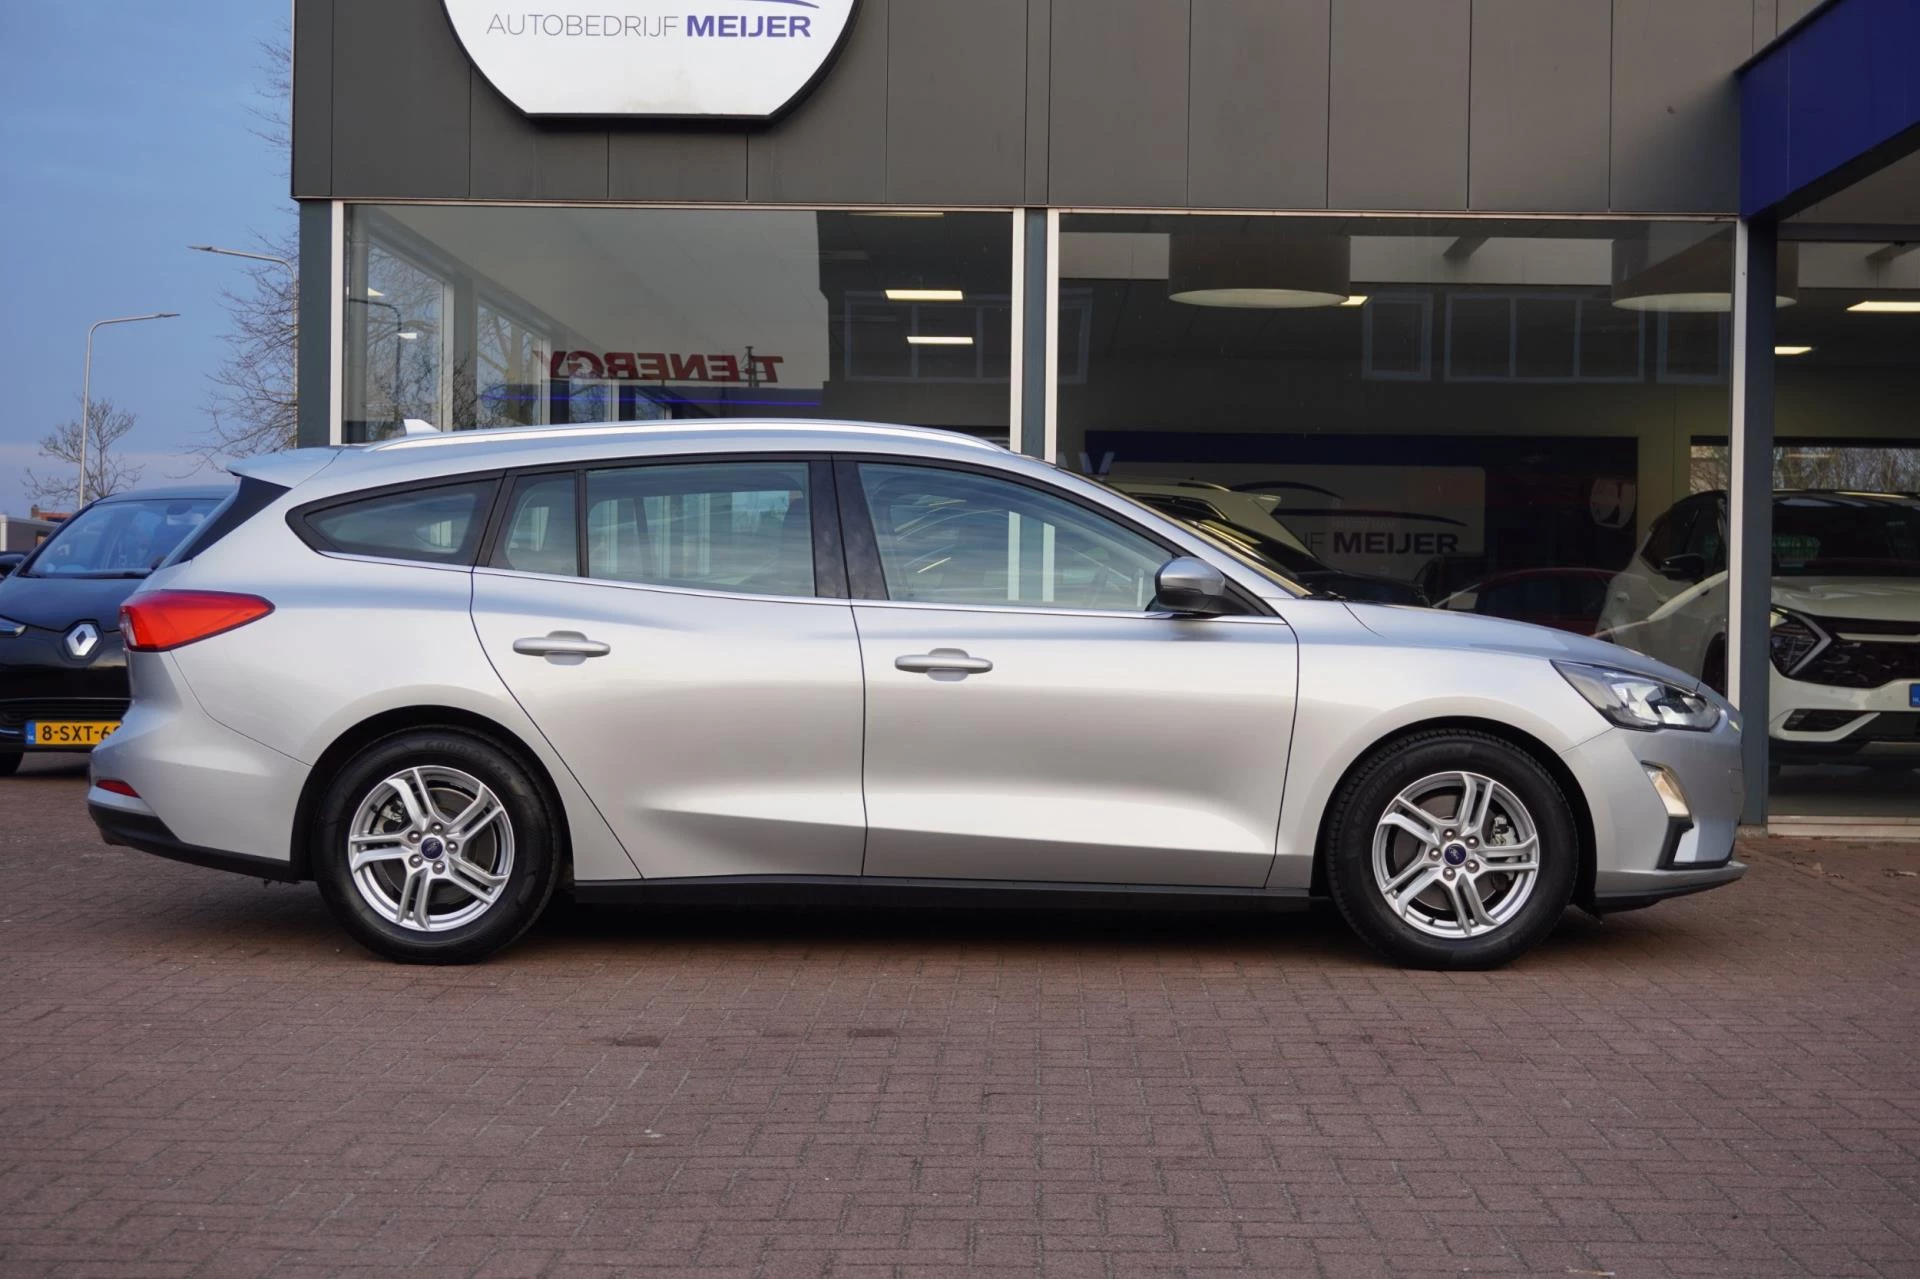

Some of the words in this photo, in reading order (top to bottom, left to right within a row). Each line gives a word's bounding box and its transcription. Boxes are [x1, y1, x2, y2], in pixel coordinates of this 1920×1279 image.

[486, 14, 680, 37] AUTOBEDRIJF
[686, 15, 811, 38] MEIJER
[1333, 532, 1459, 554] MEIJER
[42, 725, 120, 741] 8-SXT-6
